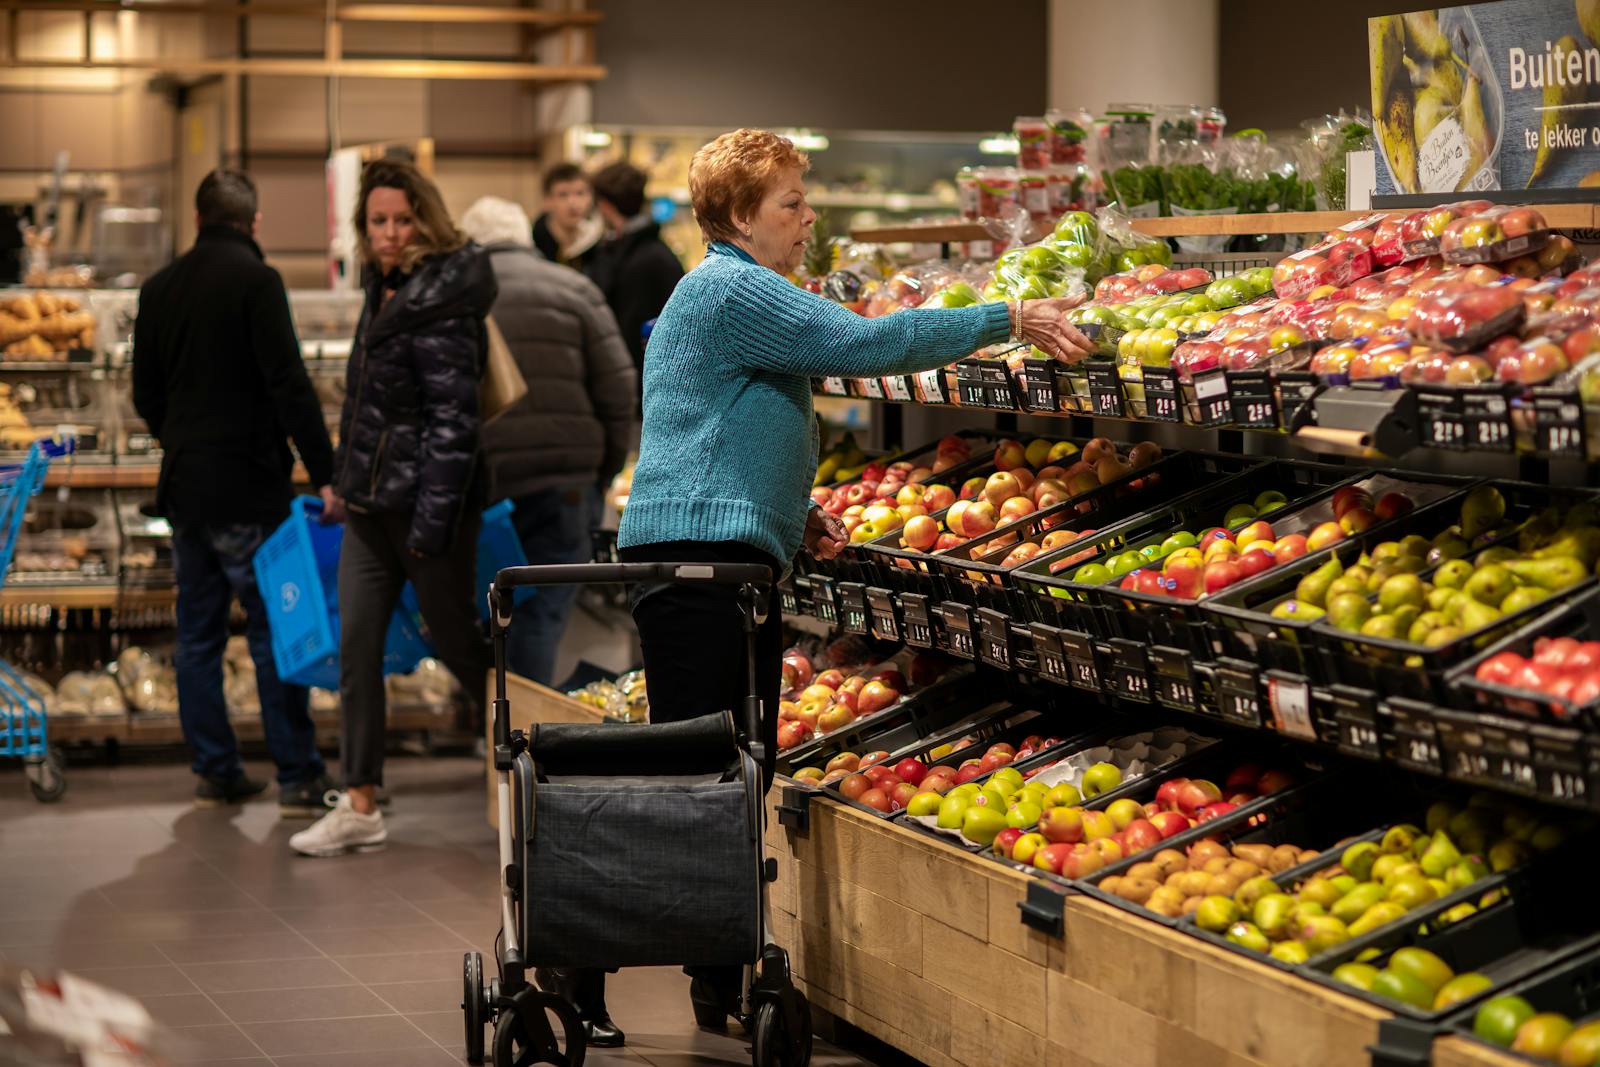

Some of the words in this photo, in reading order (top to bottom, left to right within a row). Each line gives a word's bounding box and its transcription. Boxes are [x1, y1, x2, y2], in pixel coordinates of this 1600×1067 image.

[1509, 40, 1600, 89] Buiten
[1525, 128, 1539, 149] te
[1544, 124, 1587, 148] lekker
